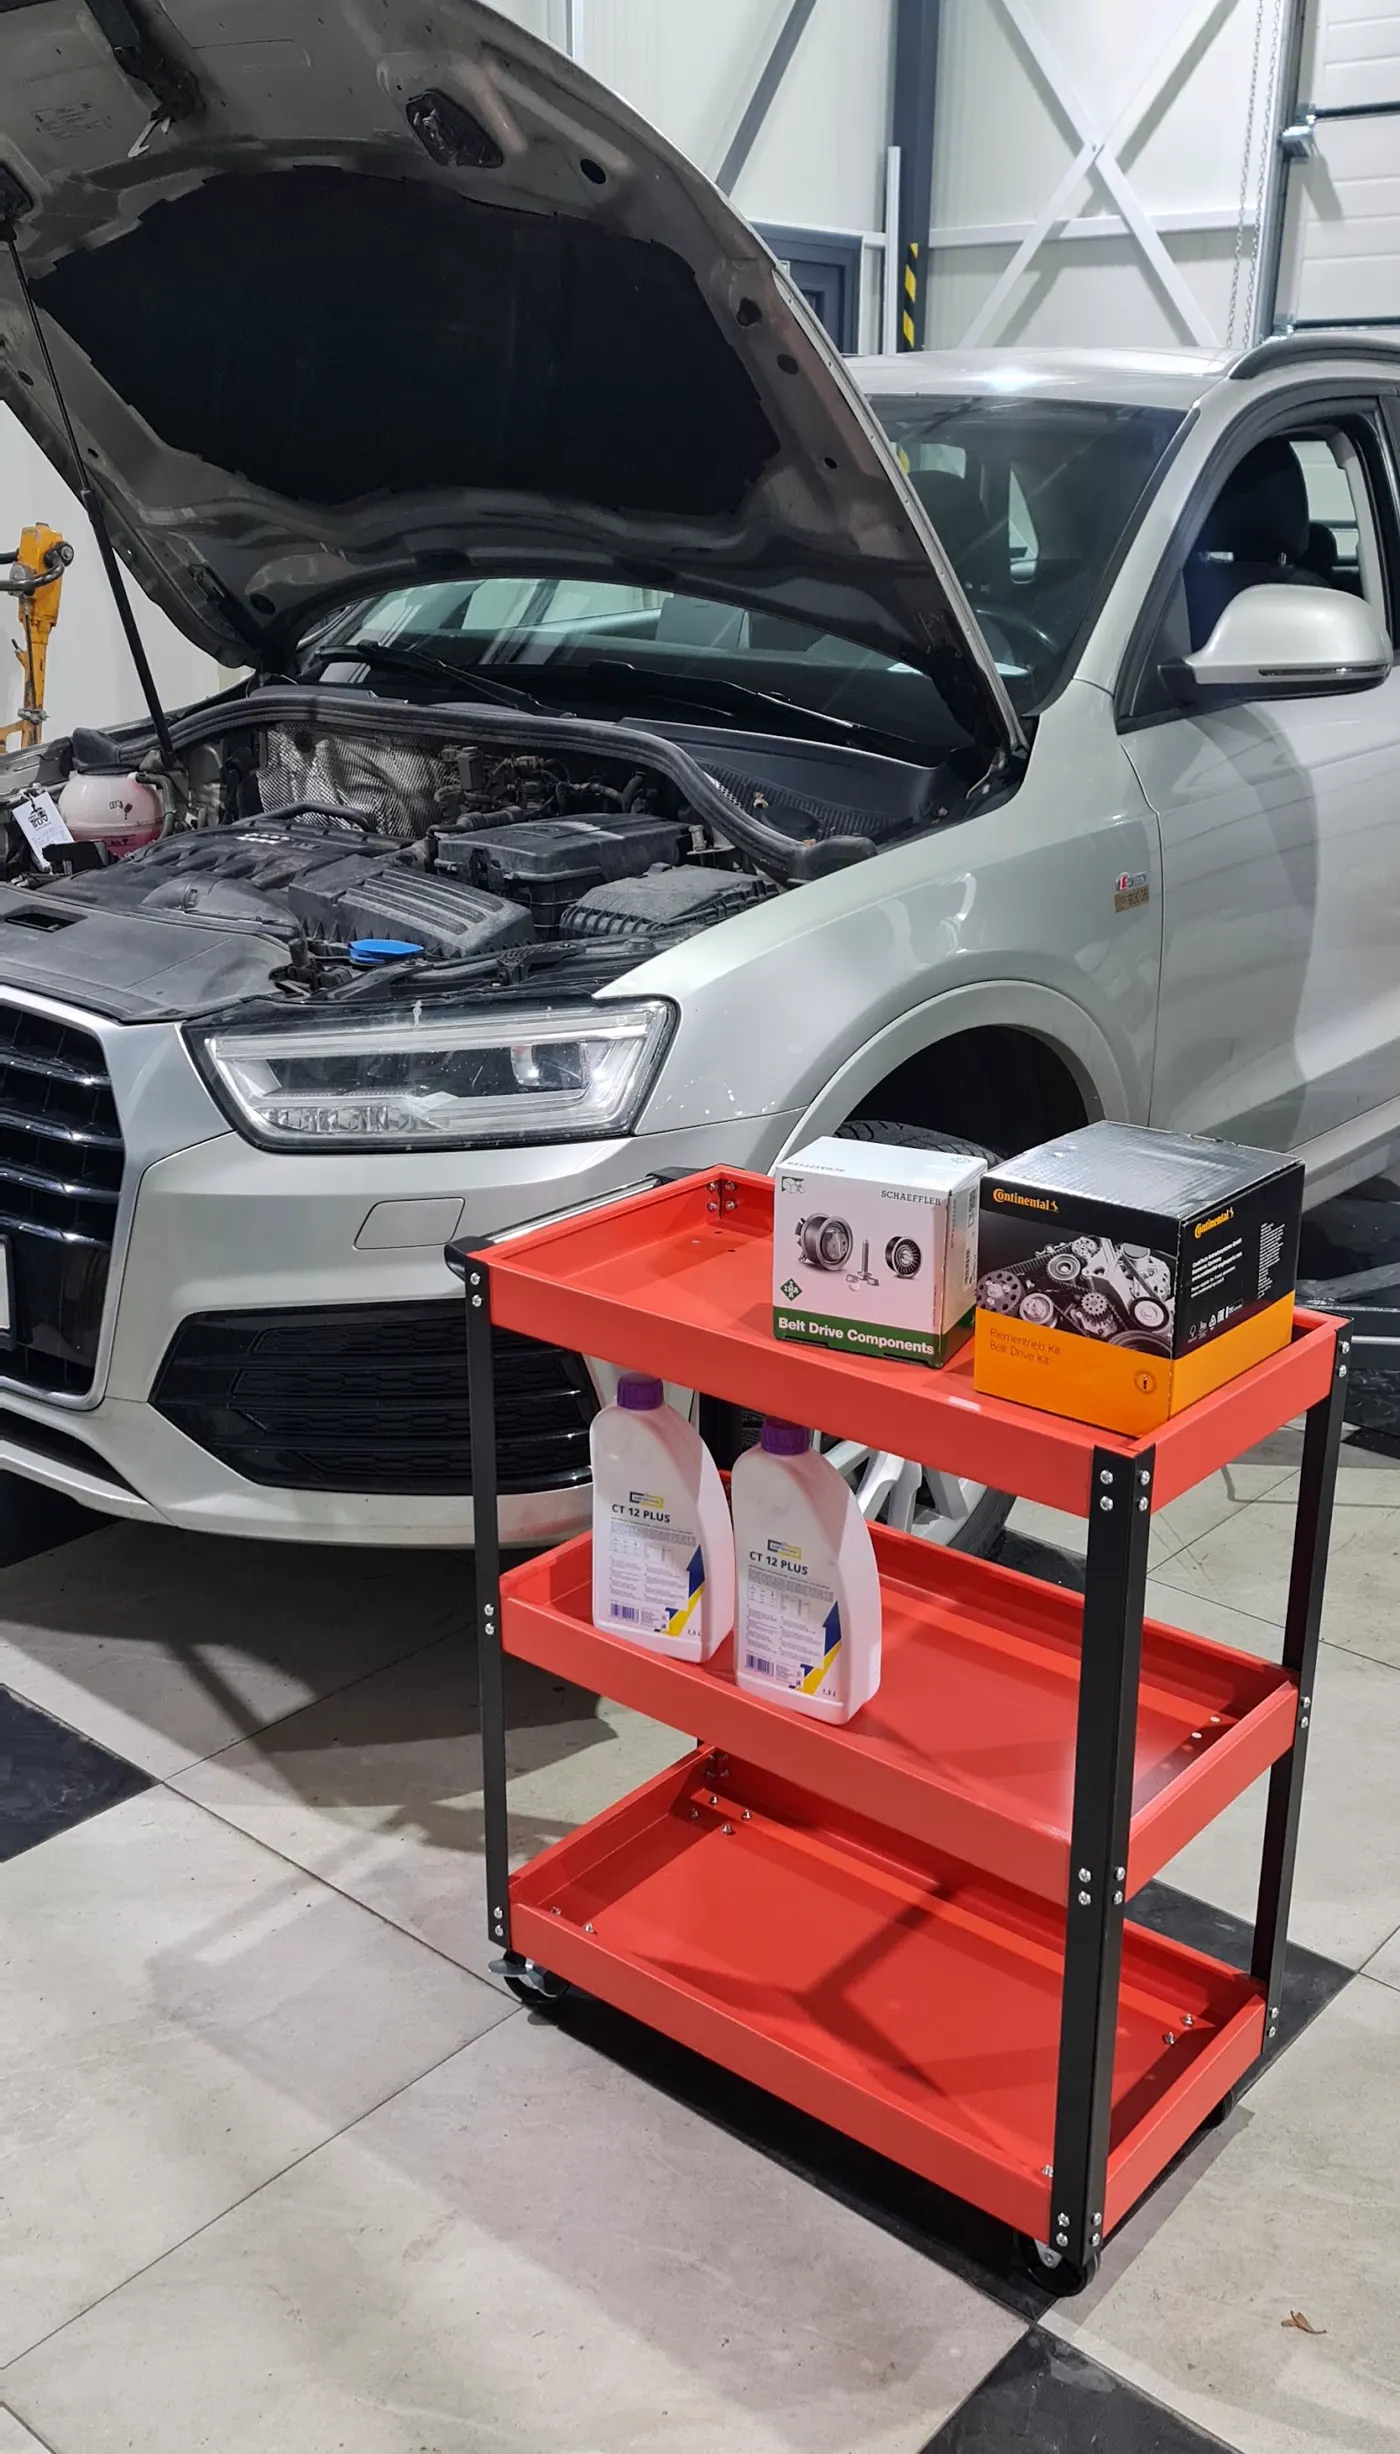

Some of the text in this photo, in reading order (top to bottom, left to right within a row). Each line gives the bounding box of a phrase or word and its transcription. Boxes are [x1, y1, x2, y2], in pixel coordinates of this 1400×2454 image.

[881, 1190, 941, 1206] SCHAEFFLER
[993, 1188, 1050, 1211] Continental
[1195, 1210, 1229, 1238] Continental
[778, 1317, 935, 1355] Belt Drive Components
[990, 1340, 1050, 1366] Belt Drive Kit
[1048, 1344, 1061, 1355] Kit
[612, 1503, 672, 1523] CT 12 PLUS
[749, 1551, 809, 1576] CT 12 PLUS
